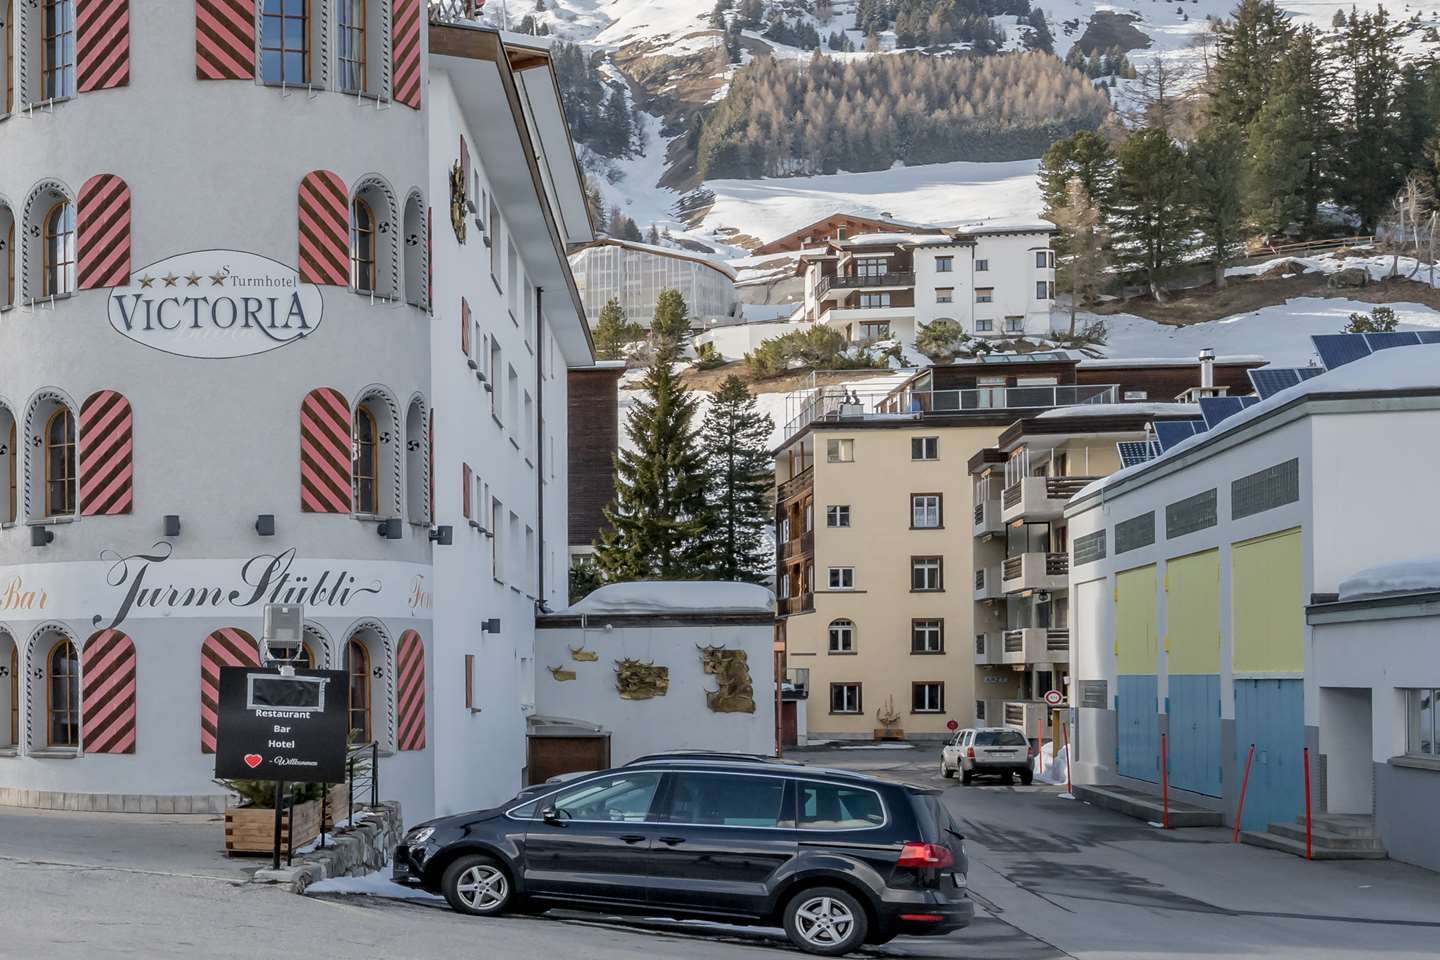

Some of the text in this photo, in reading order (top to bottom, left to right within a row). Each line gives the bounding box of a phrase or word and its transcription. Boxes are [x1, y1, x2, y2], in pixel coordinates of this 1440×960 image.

[231, 275, 297, 288] Turmhotel
[113, 290, 313, 342] VICTORIA
[0, 576, 48, 610] Bar
[255, 709, 311, 719] Restaurant
[273, 724, 291, 733] Bar
[268, 740, 295, 748] Hotel
